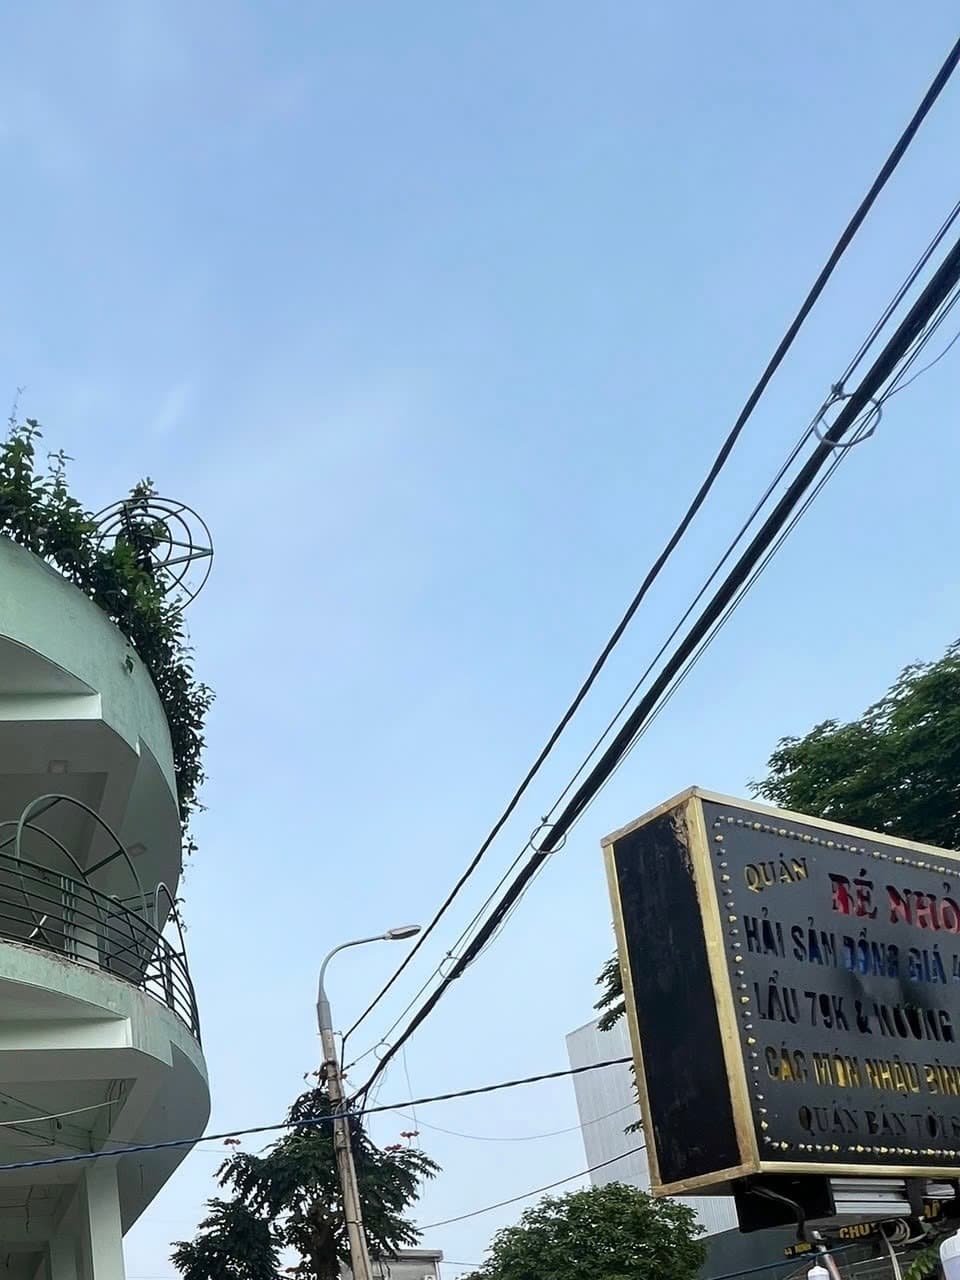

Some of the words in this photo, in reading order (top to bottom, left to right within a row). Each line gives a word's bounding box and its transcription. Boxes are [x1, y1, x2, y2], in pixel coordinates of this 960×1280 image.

[744, 852, 809, 893] QUÁN
[828, 868, 879, 919] BÉ
[743, 906, 785, 959] HẢI
[791, 916, 837, 968] SẢN
[908, 943, 947, 984] GIÁ
[754, 970, 800, 1024] LẨU
[804, 991, 850, 1031] 79K
[855, 1000, 872, 1034] &
[765, 1041, 807, 1083] CÁC
[812, 1047, 860, 1088] MÓN
[798, 1100, 858, 1136] QUÁN
[864, 1104, 907, 1136] BÁN
